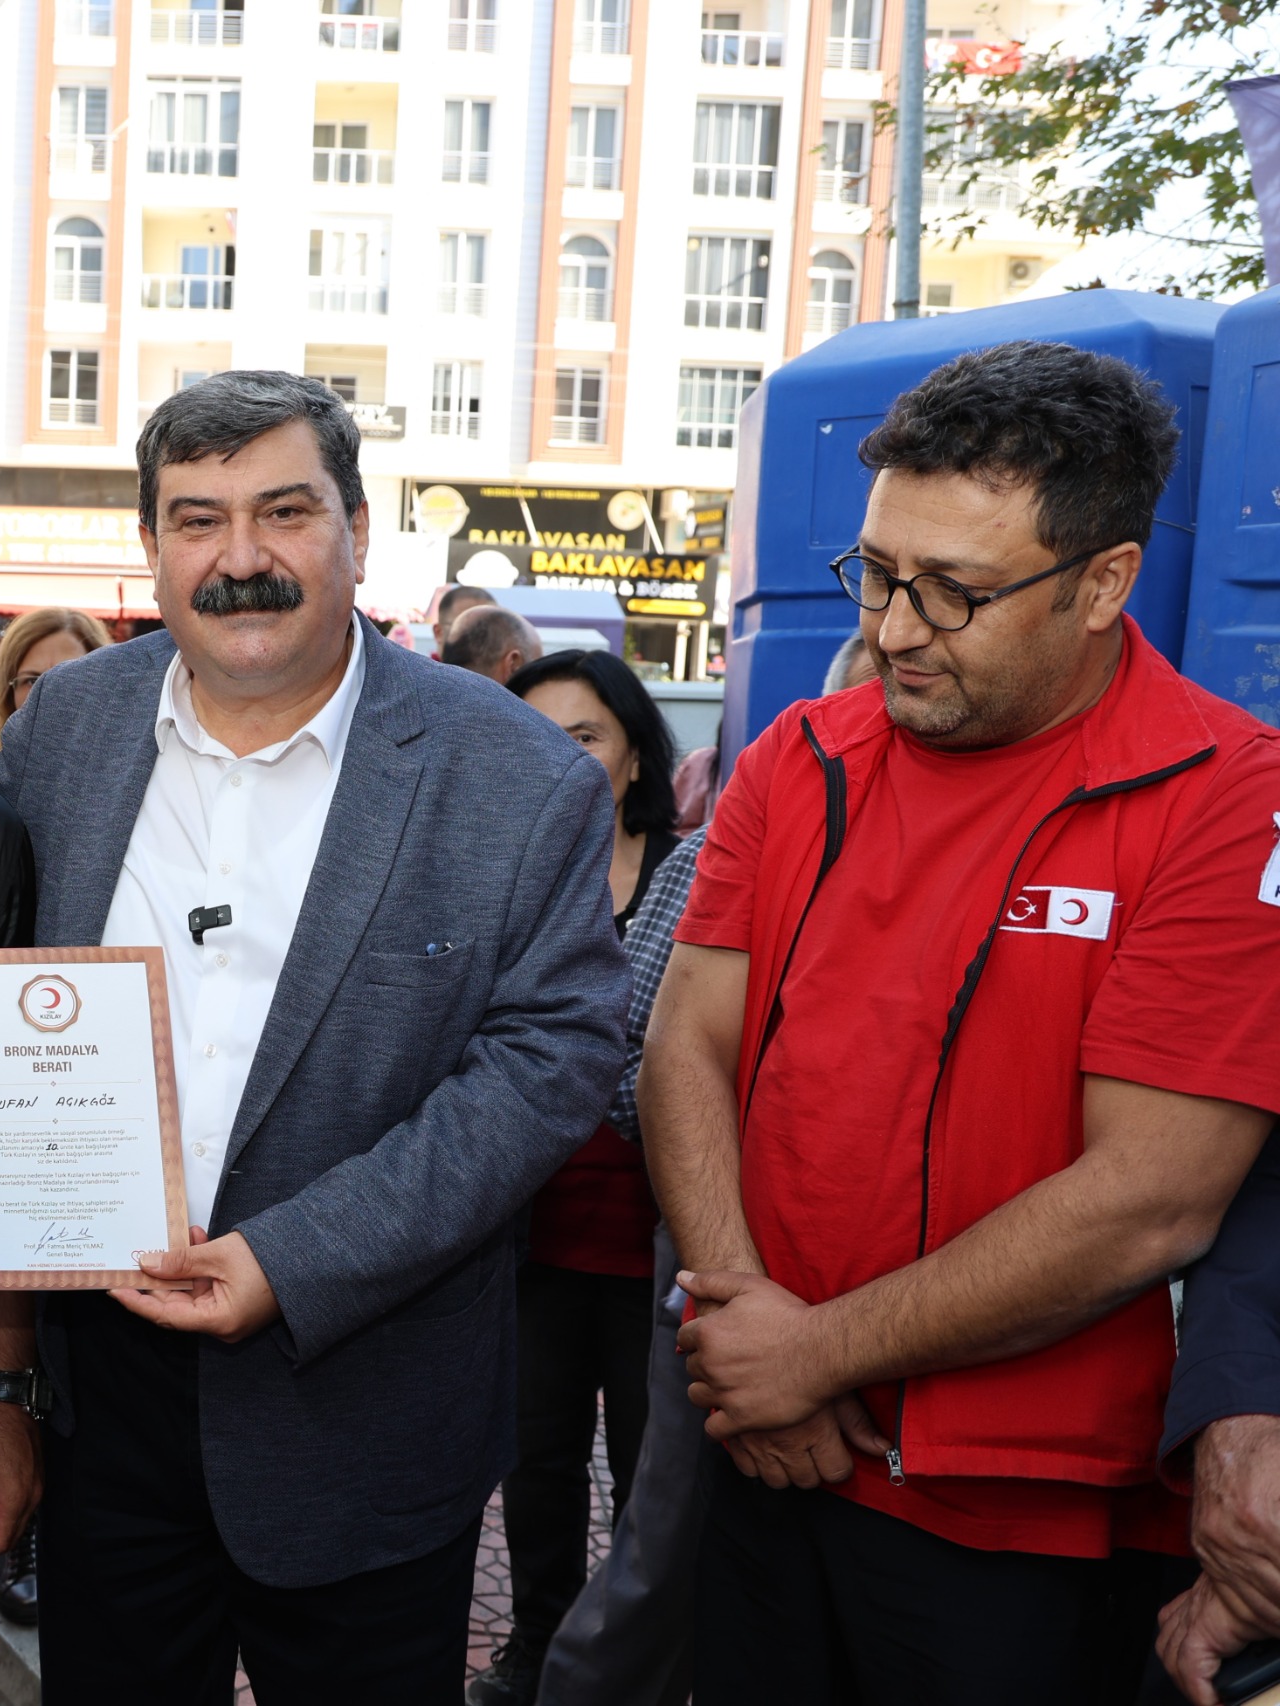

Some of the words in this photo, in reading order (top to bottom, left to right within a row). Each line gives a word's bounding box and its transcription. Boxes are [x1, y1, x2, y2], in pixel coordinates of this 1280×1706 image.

[531, 550, 706, 582] BAKLAVASAN
[618, 580, 634, 596] &
[4, 1046, 42, 1056] BRONZ
[46, 1044, 99, 1056] MADALYA
[32, 1062, 72, 1072] BERATI
